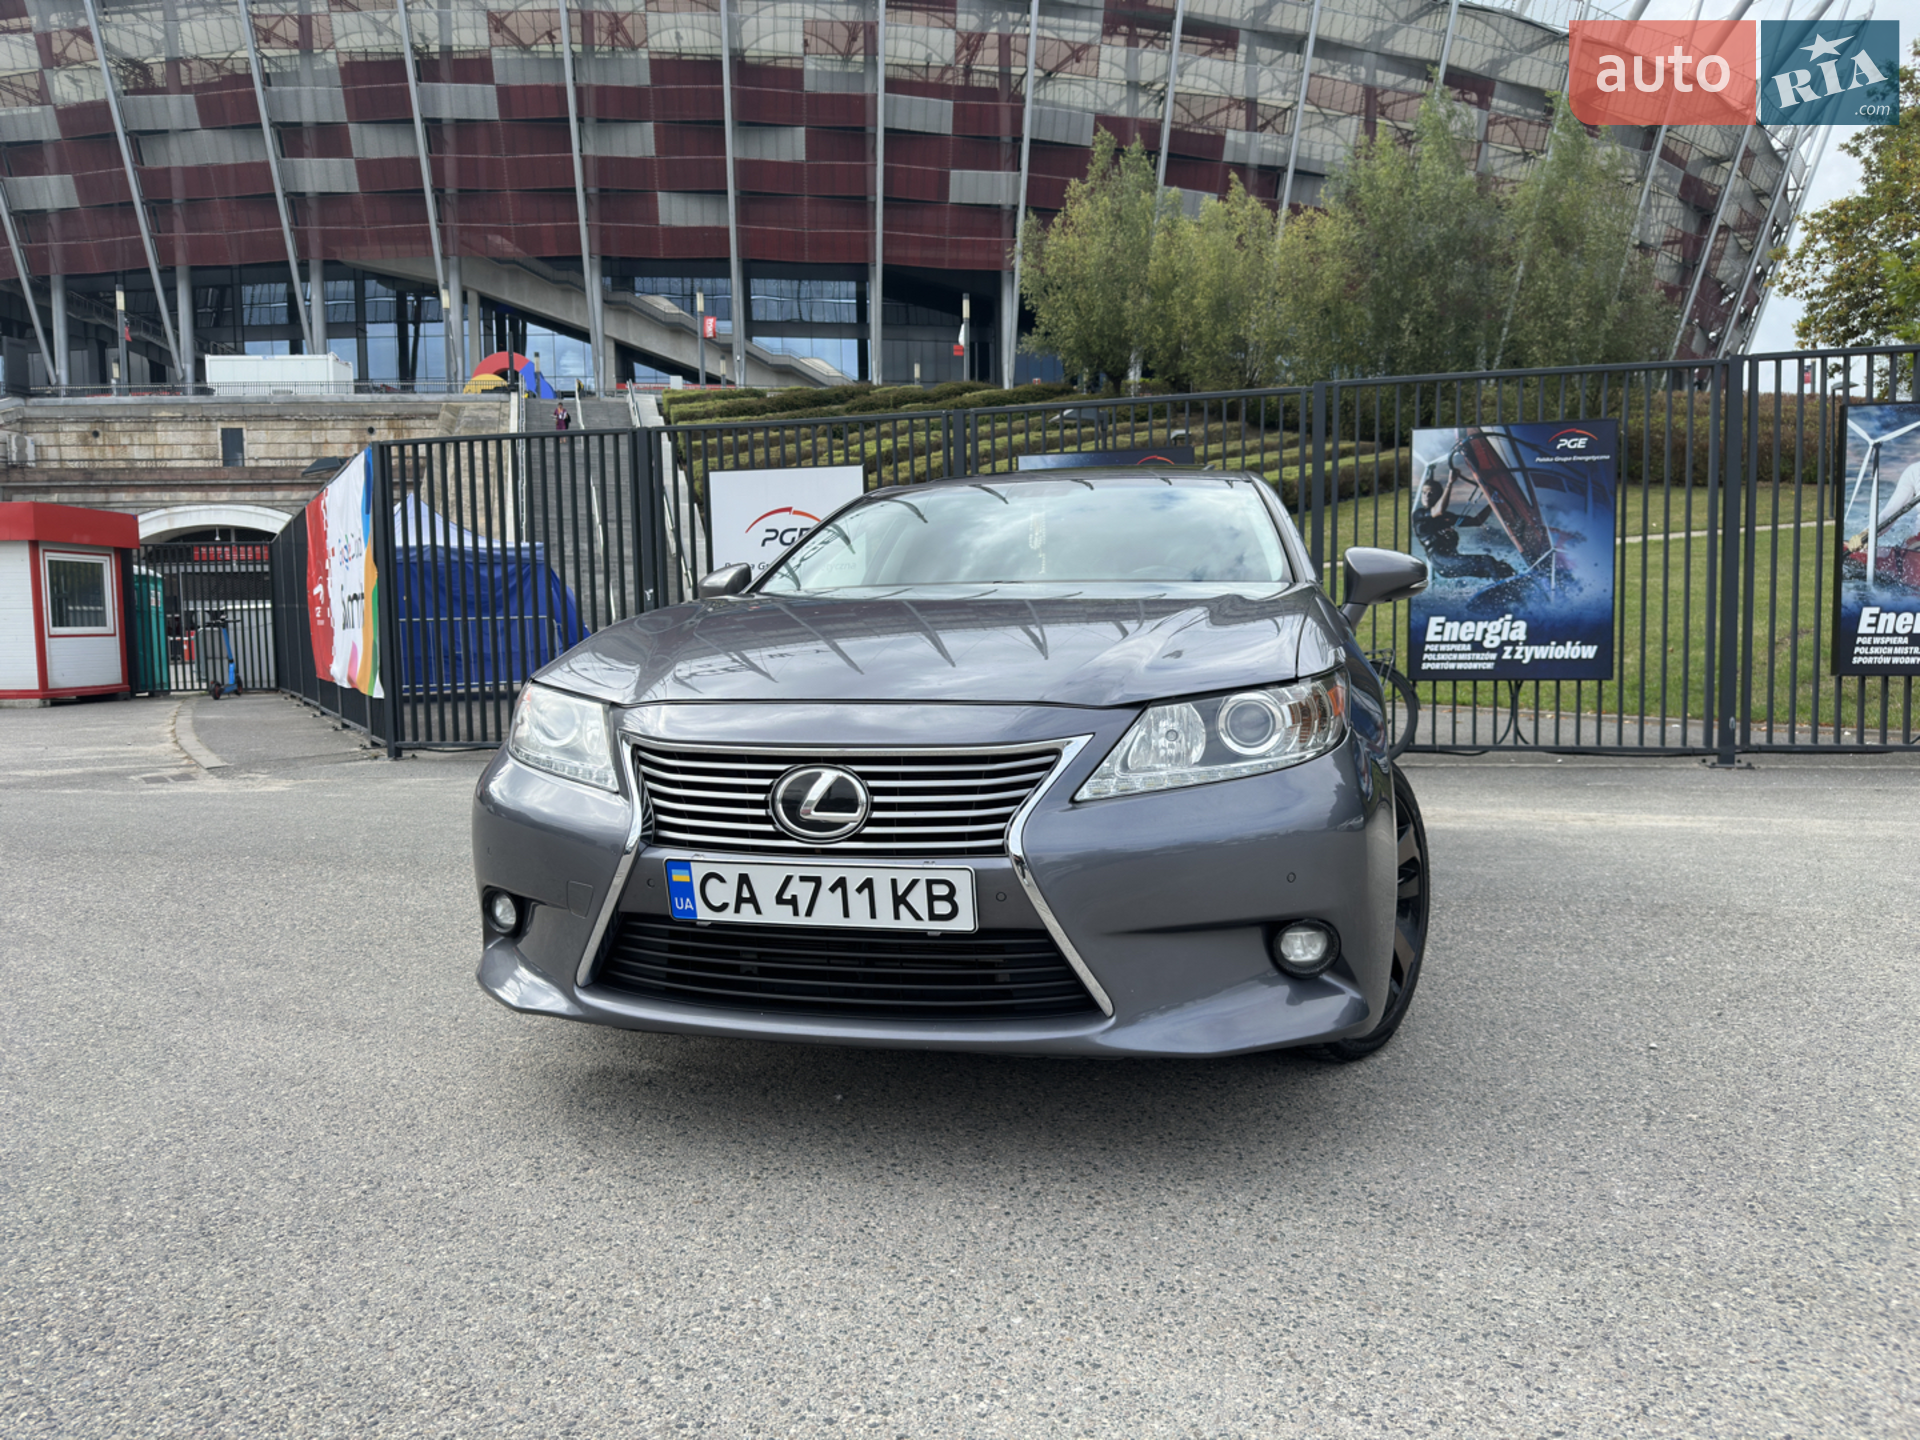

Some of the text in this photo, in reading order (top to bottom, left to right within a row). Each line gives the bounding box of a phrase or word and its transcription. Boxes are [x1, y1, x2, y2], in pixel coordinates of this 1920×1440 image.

[1556, 437, 1588, 450] PGE
[1425, 614, 1527, 648] Energia
[1856, 636, 1909, 645] PGE WSPIERA
[1440, 643, 1472, 651] WSPIERA
[1854, 646, 1893, 655] POLSKICH
[1422, 651, 1498, 660] POLSKICH MISTRZÓW
[1501, 641, 1599, 664] z żywiołów
[1852, 654, 1891, 664] SPORTÓW
[1421, 661, 1455, 670] SPORTÓW
[700, 872, 959, 921] CA 4711 KB
[675, 898, 694, 911] UA
